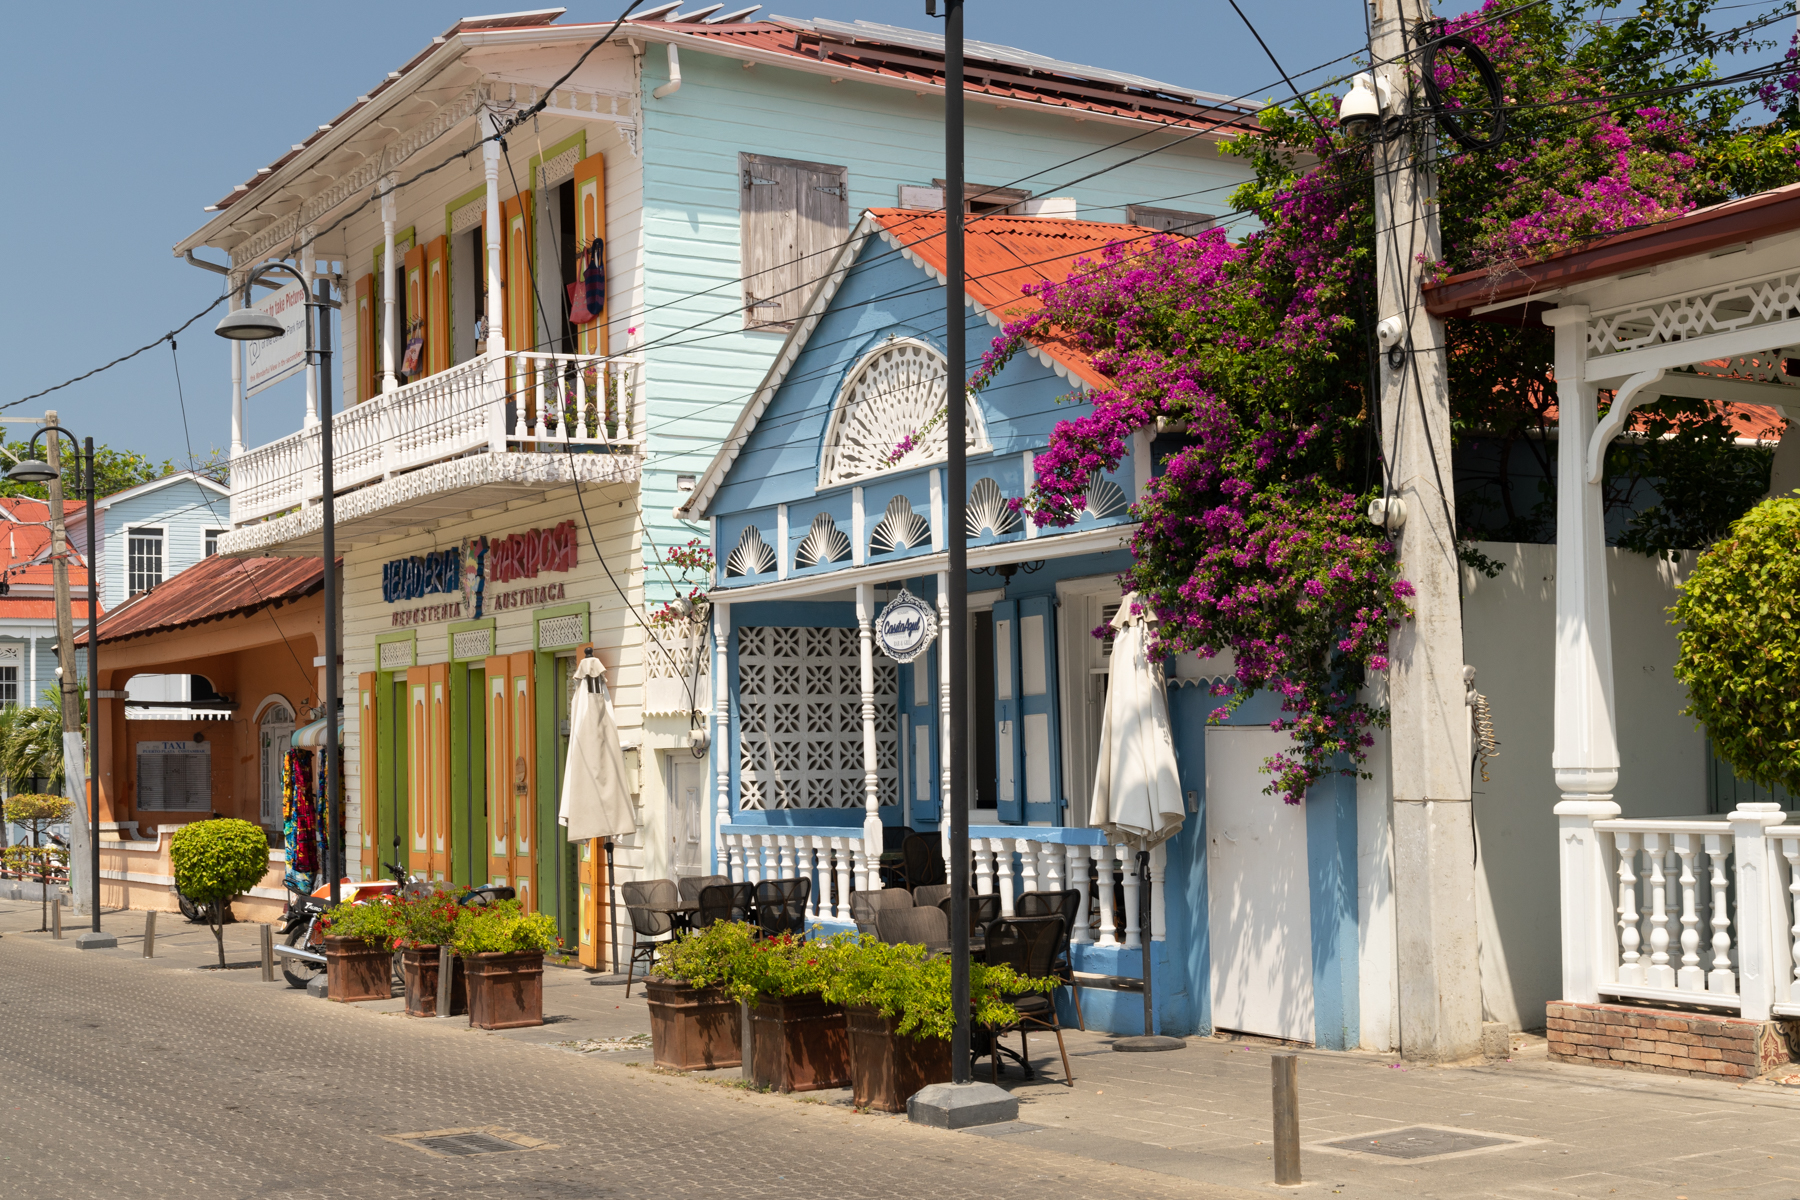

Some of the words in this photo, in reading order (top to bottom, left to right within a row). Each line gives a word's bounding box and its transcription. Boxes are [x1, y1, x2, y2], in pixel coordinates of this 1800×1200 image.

[269, 304, 274, 317] to
[275, 298, 286, 315] take
[286, 288, 304, 309] Pictures
[287, 323, 296, 336] Park
[296, 319, 306, 331] from
[270, 363, 278, 372] View
[382, 546, 460, 603] HELADERIA
[490, 519, 578, 583] MARIPOSA
[392, 602, 461, 626] REPOSTERIA
[494, 582, 565, 610] AUSTRIACA
[162, 741, 186, 750] TAXI
